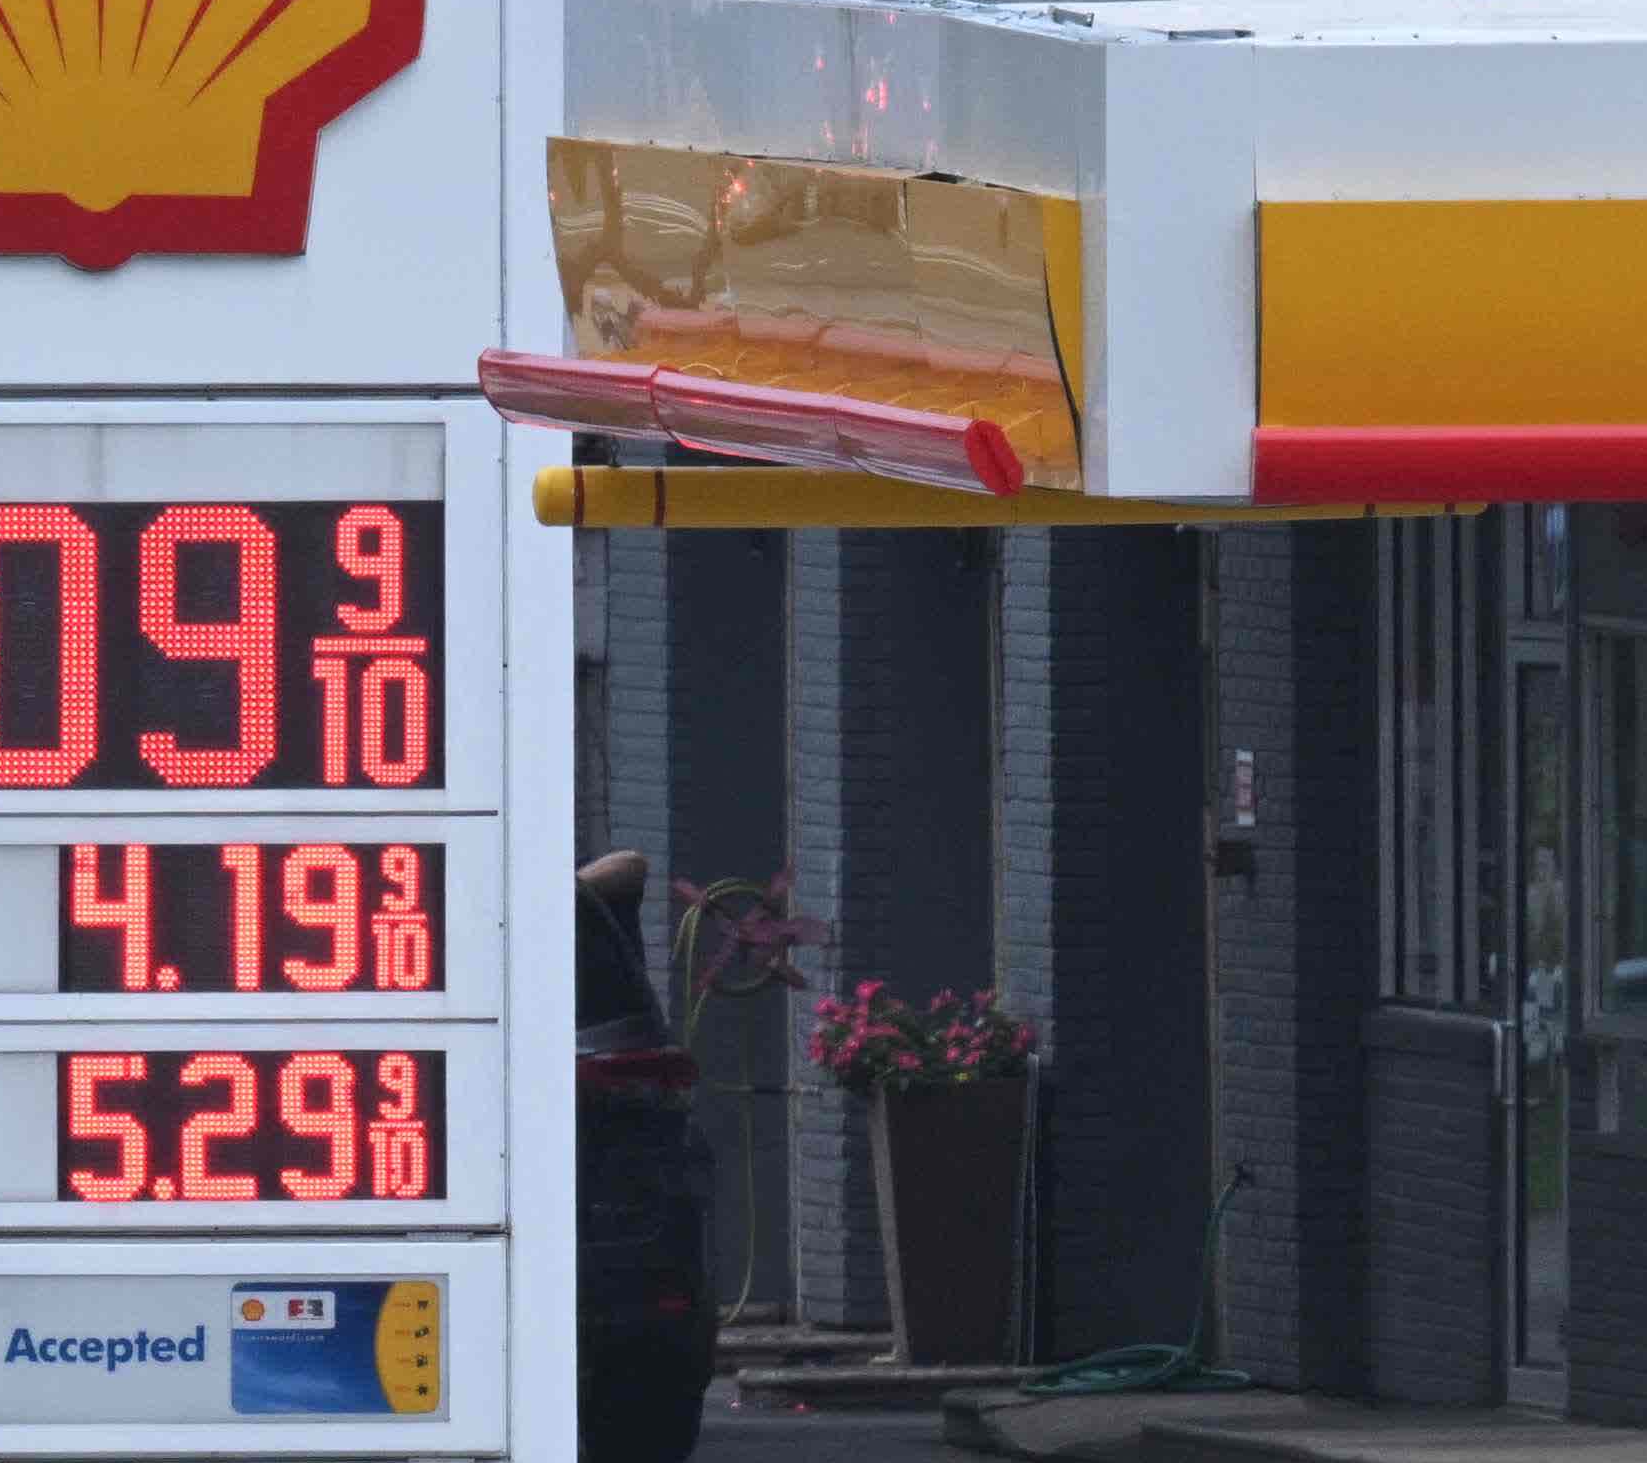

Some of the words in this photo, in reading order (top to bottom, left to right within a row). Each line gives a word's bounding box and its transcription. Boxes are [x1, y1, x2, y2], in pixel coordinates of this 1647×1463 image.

[72, 842, 362, 991] 4.19
[68, 1053, 357, 1201] 5.29
[3, 1326, 205, 1372] Accepted
